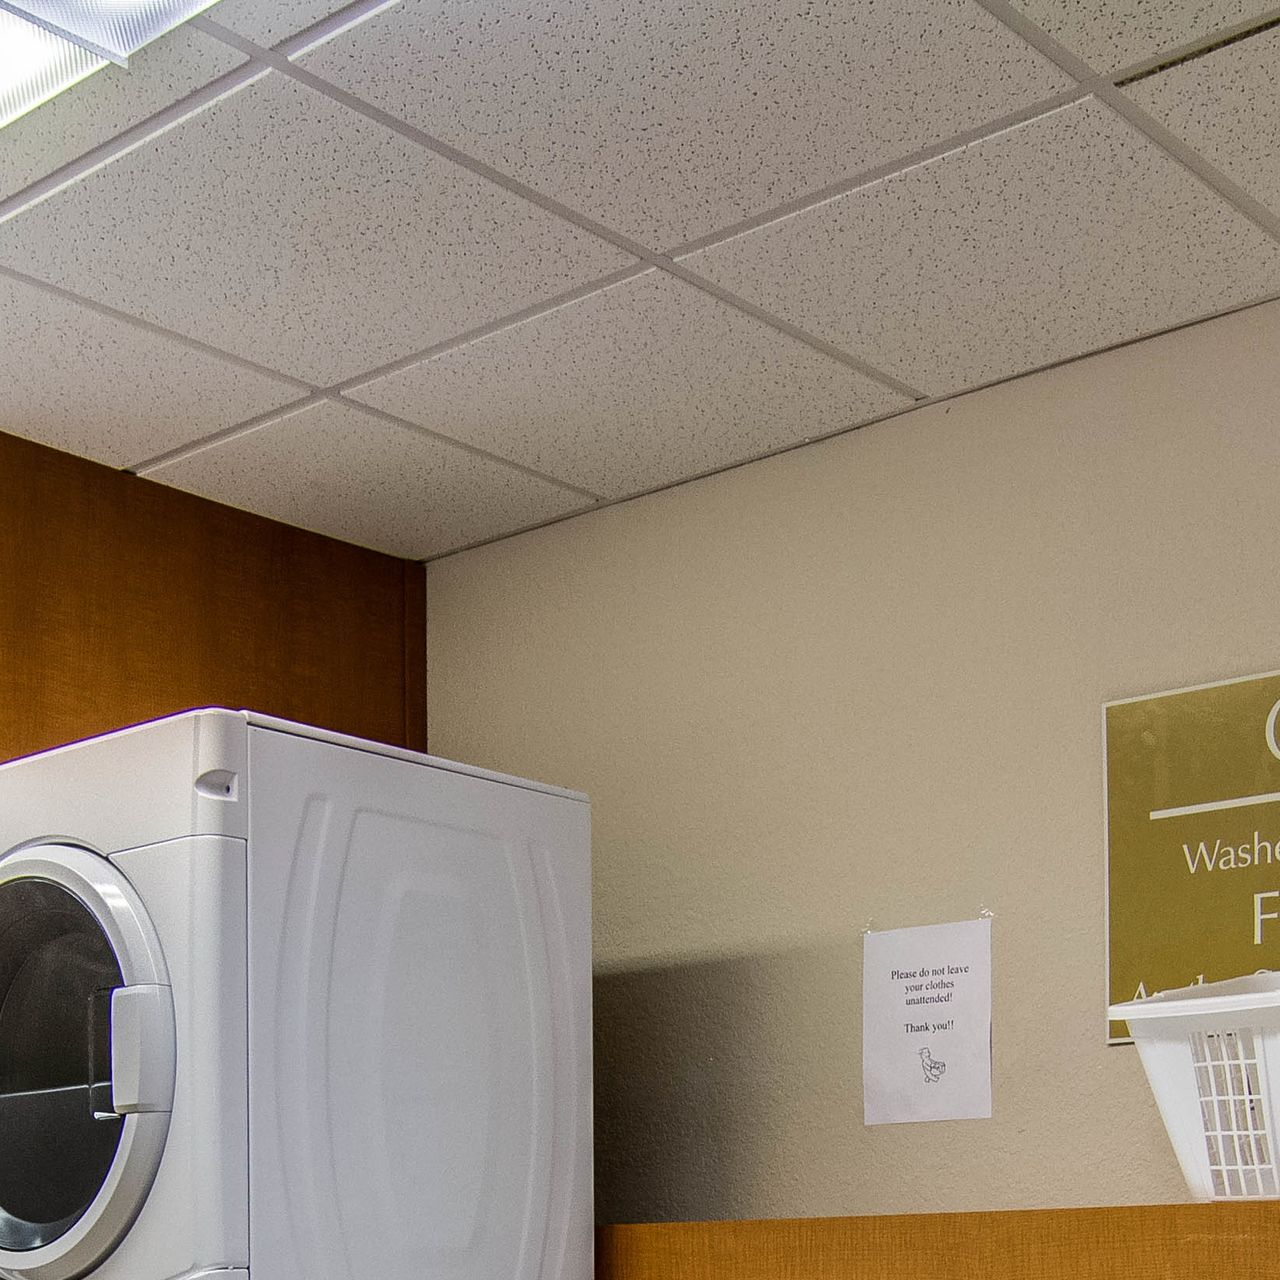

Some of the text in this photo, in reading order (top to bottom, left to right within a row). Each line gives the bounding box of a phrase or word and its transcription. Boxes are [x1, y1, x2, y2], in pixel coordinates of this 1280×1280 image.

[891, 965, 969, 979] Please do not leave
[905, 980, 954, 994] your clothes
[905, 992, 952, 1005] unattended!
[904, 1020, 954, 1033] Thank you!!
